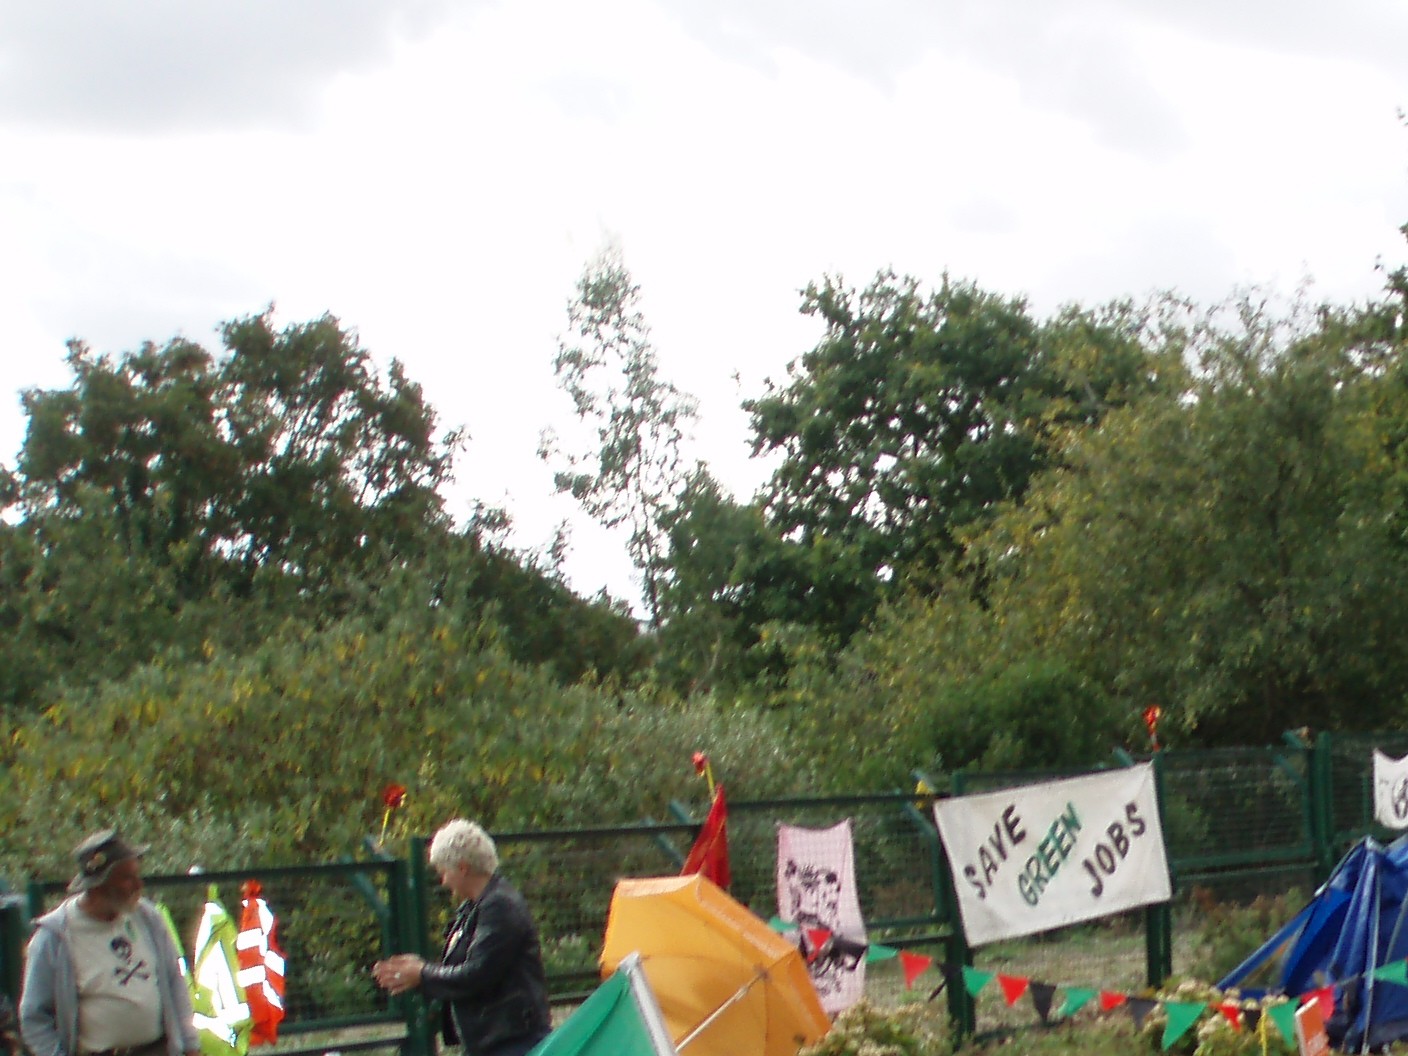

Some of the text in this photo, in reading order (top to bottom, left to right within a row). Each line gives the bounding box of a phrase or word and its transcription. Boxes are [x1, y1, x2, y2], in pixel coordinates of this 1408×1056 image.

[963, 804, 1027, 900] SAVE
[1017, 801, 1082, 907] GREEN
[1082, 801, 1146, 898] JOBS
